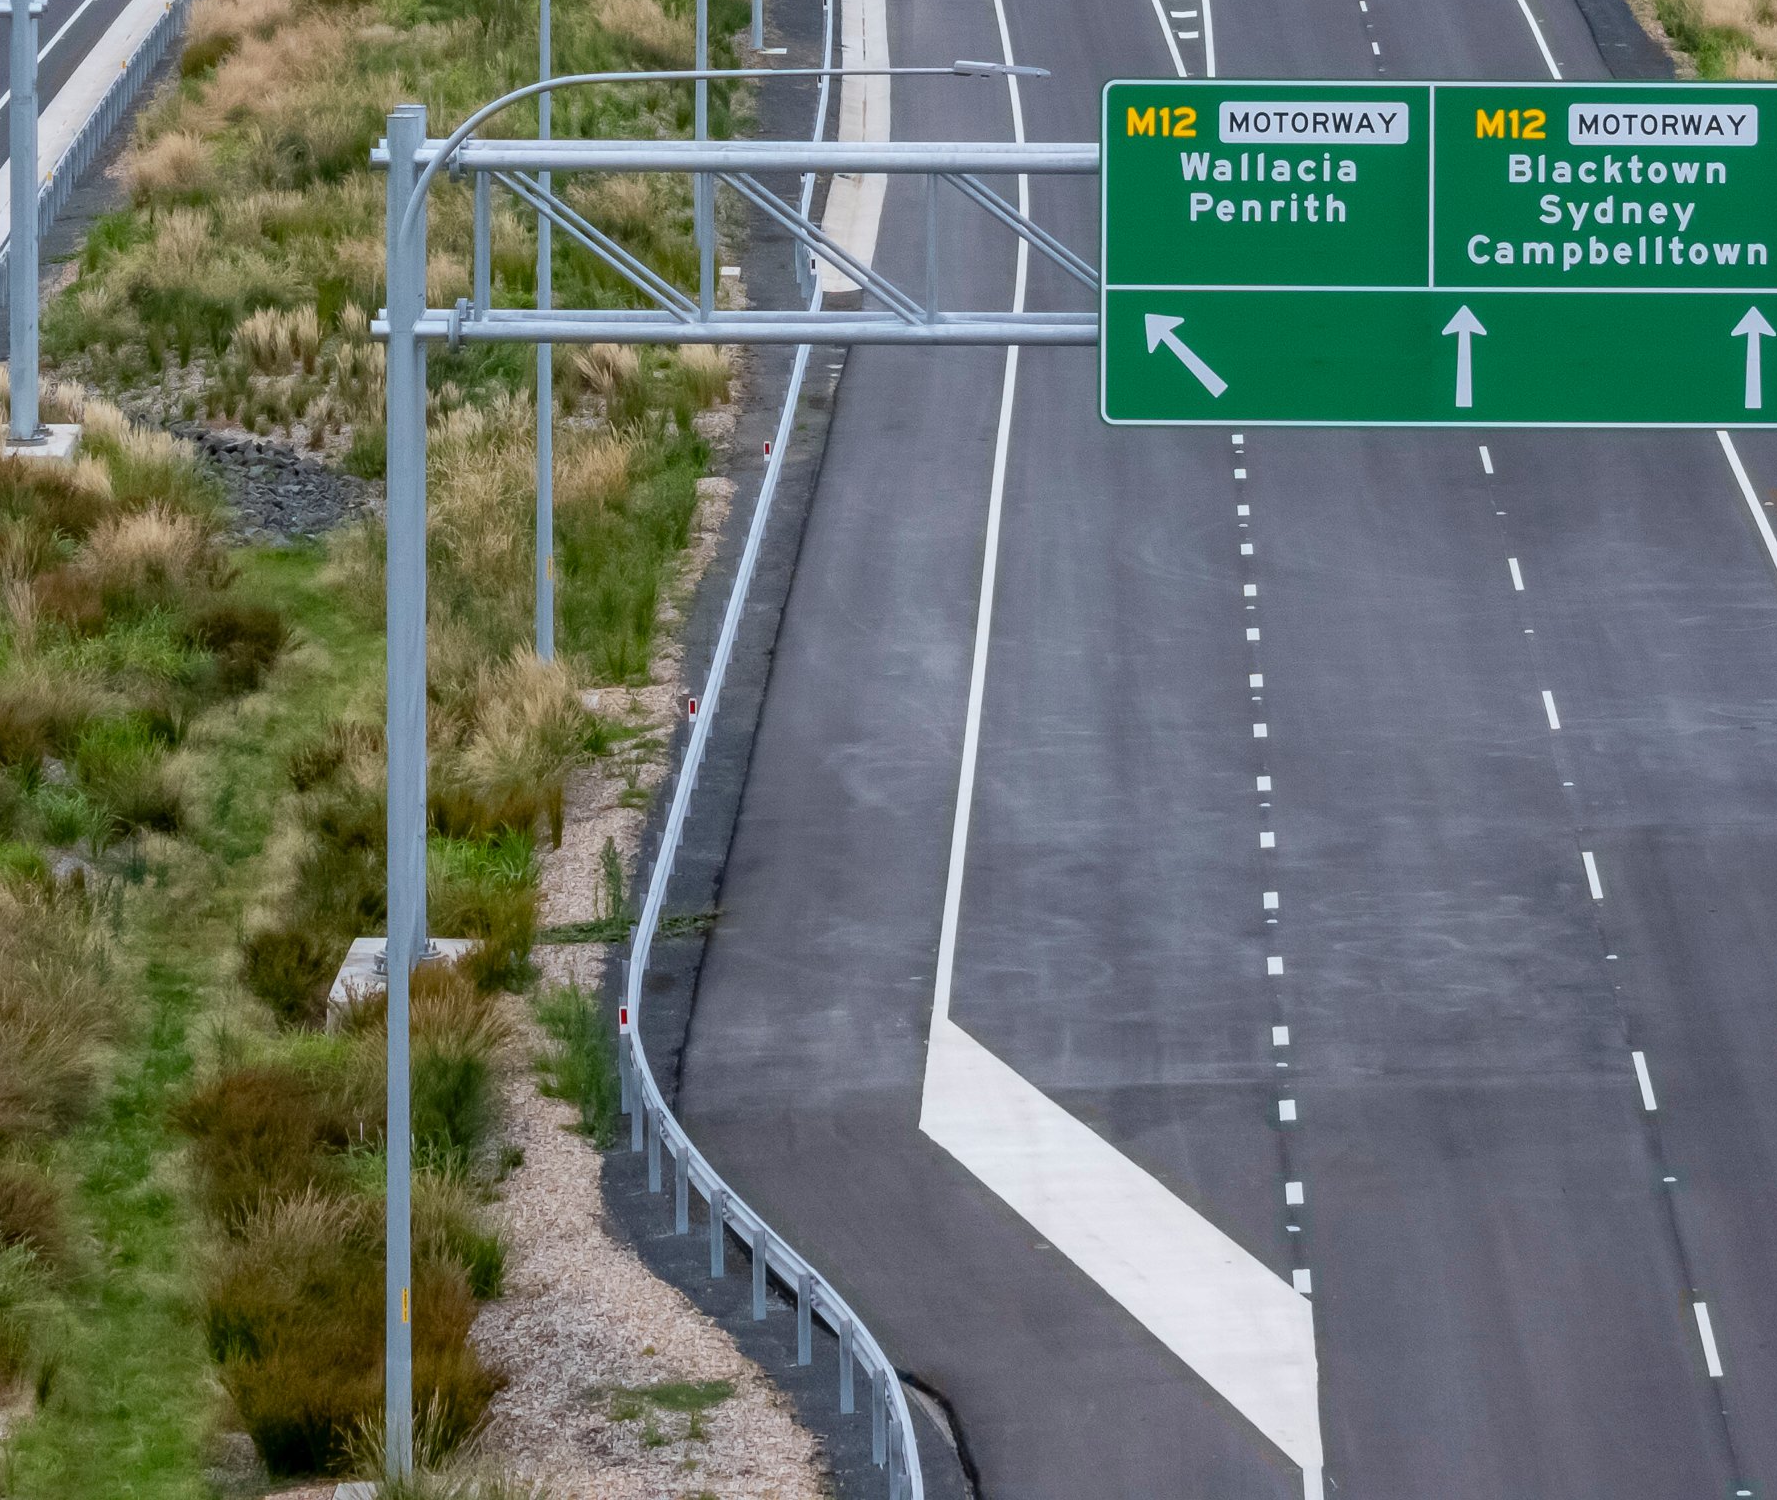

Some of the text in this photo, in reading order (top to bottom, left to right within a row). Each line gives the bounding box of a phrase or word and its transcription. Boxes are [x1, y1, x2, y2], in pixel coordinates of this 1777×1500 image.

[1127, 106, 1399, 137] M12 MOTORWAY
[1476, 108, 1747, 139] M12 MOTORWAY
[1180, 152, 1357, 183] Wallacia
[1508, 154, 1727, 185] Blacktown
[1190, 192, 1347, 223] Penrith
[1539, 194, 1696, 232] Sydney
[1467, 233, 1769, 271] Campbelltown
